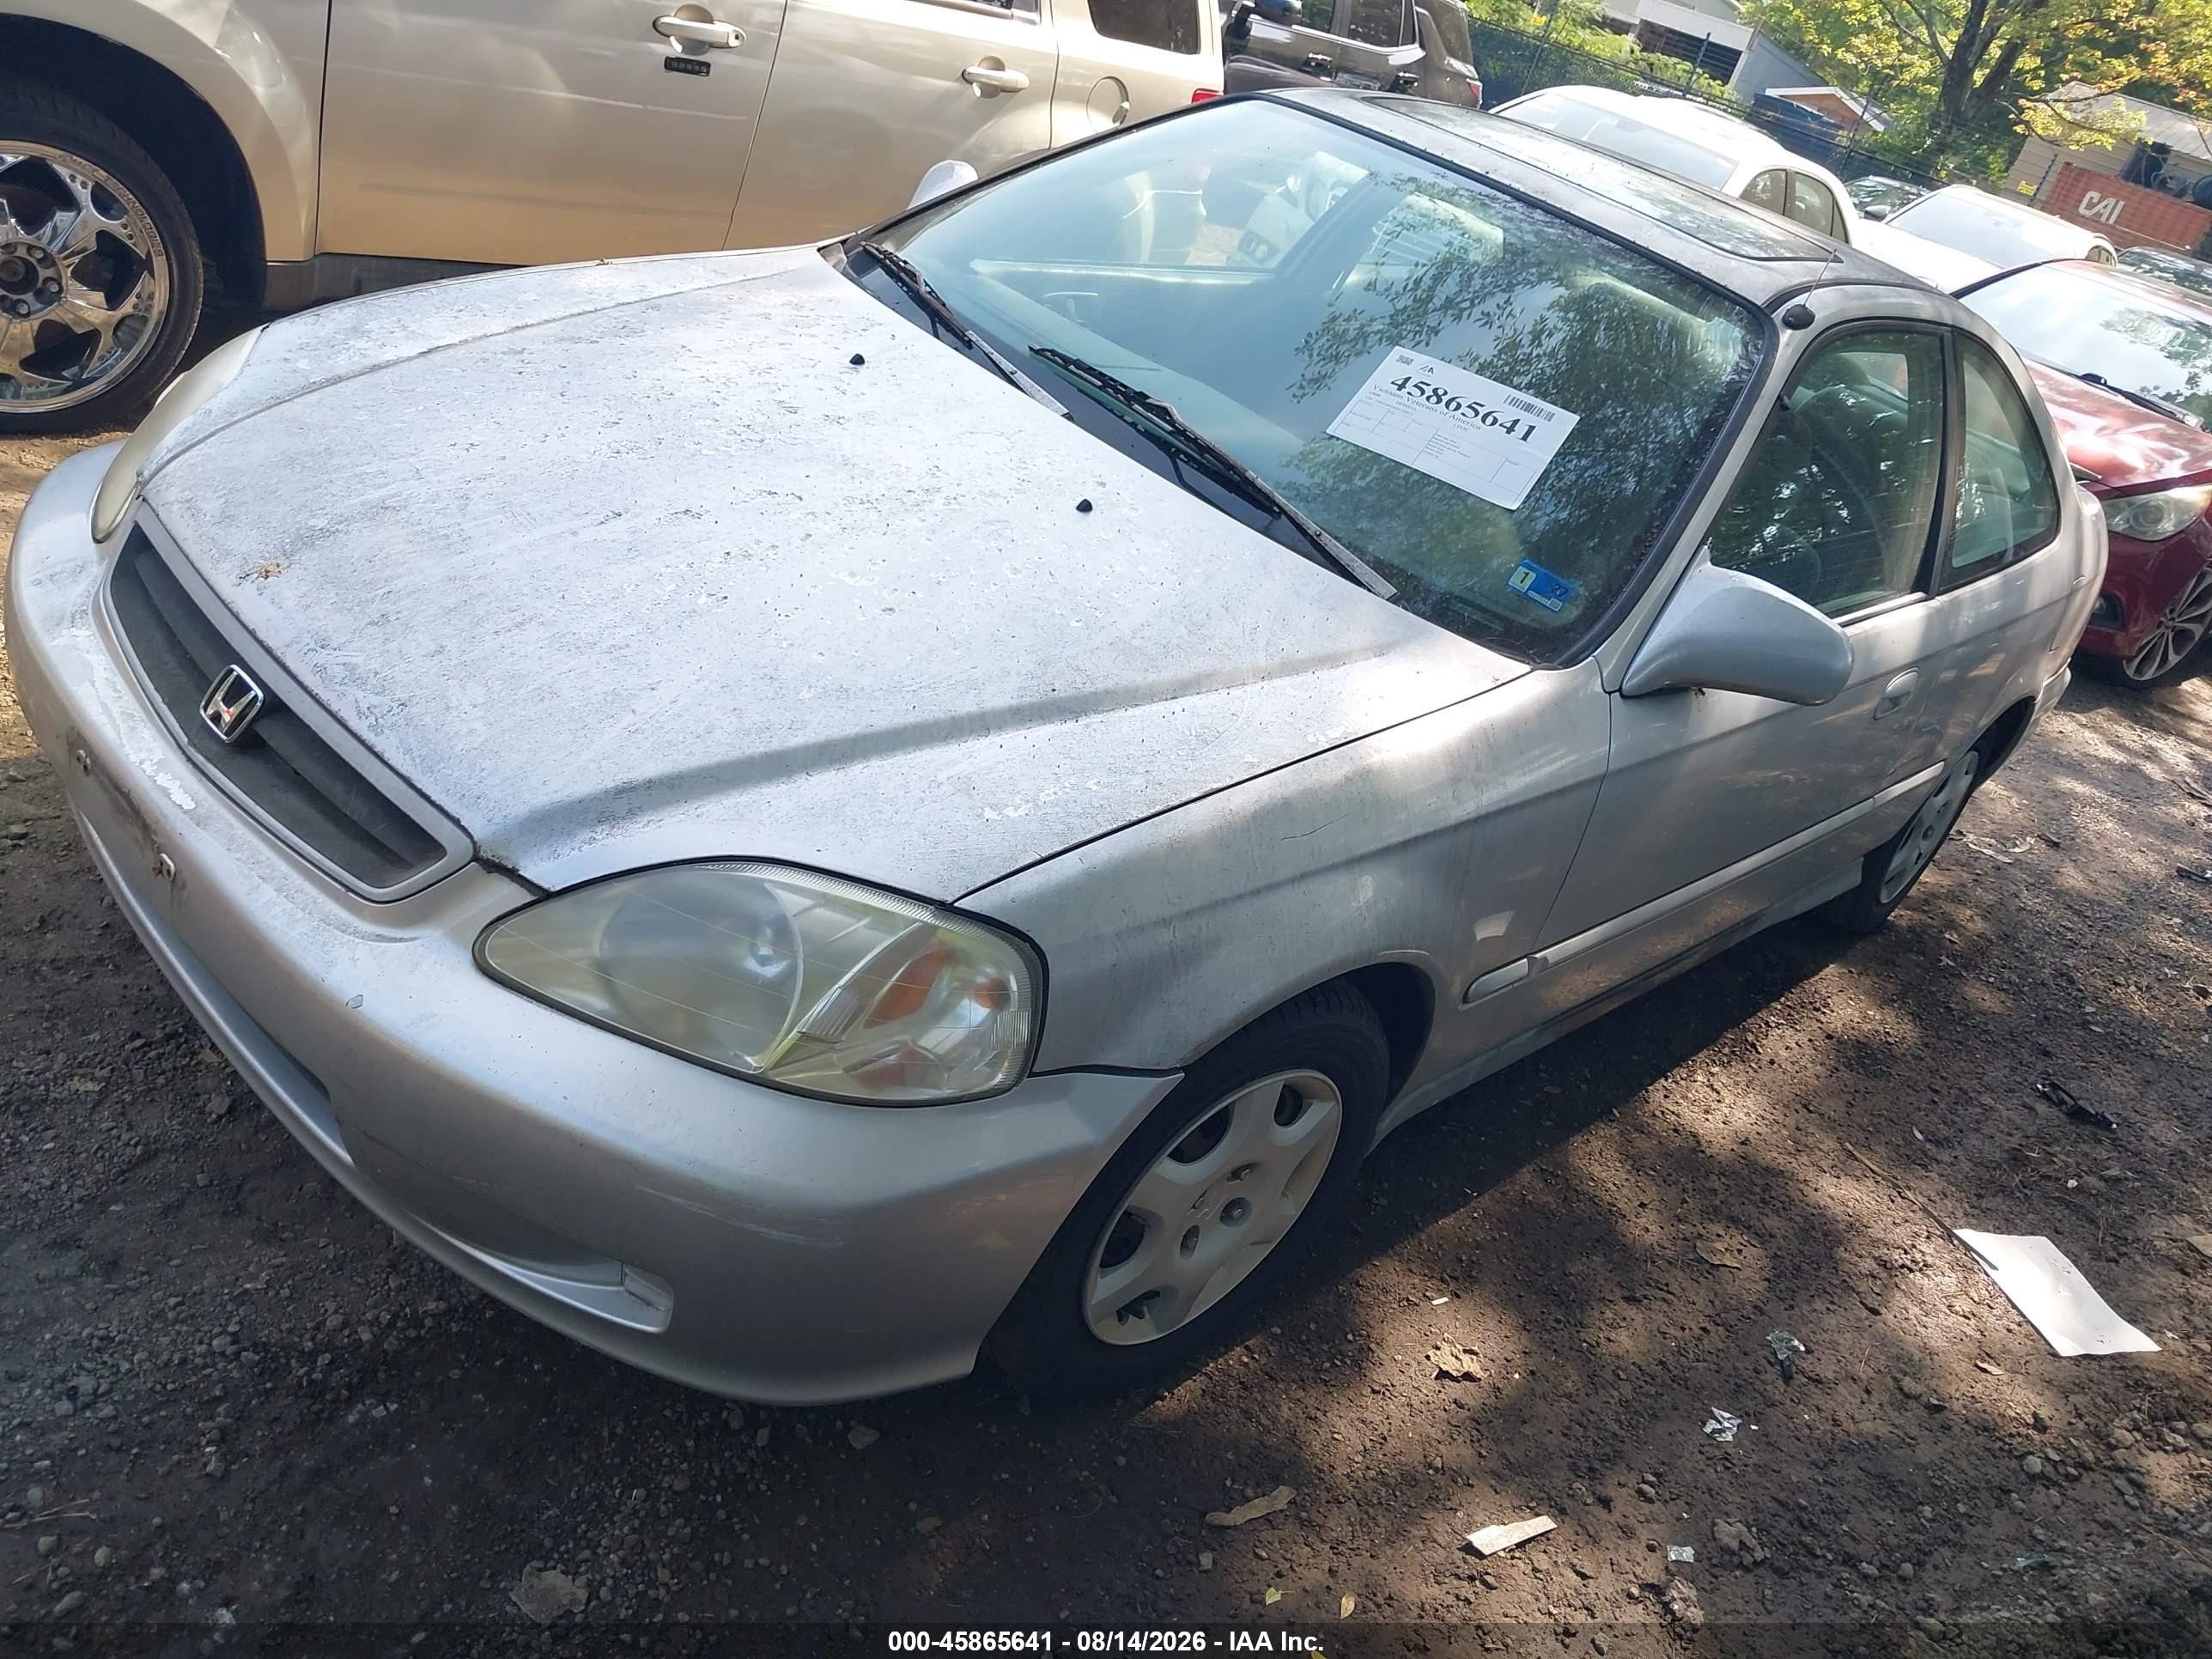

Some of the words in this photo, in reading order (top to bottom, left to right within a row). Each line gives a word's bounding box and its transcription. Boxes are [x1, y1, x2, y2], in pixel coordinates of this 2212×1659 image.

[2078, 191, 2126, 225] CAI
[1374, 384, 1404, 400] Vietnam
[1407, 396, 1437, 413] Veterans
[1448, 413, 1482, 430] America
[1390, 376, 1537, 443] 45865641
